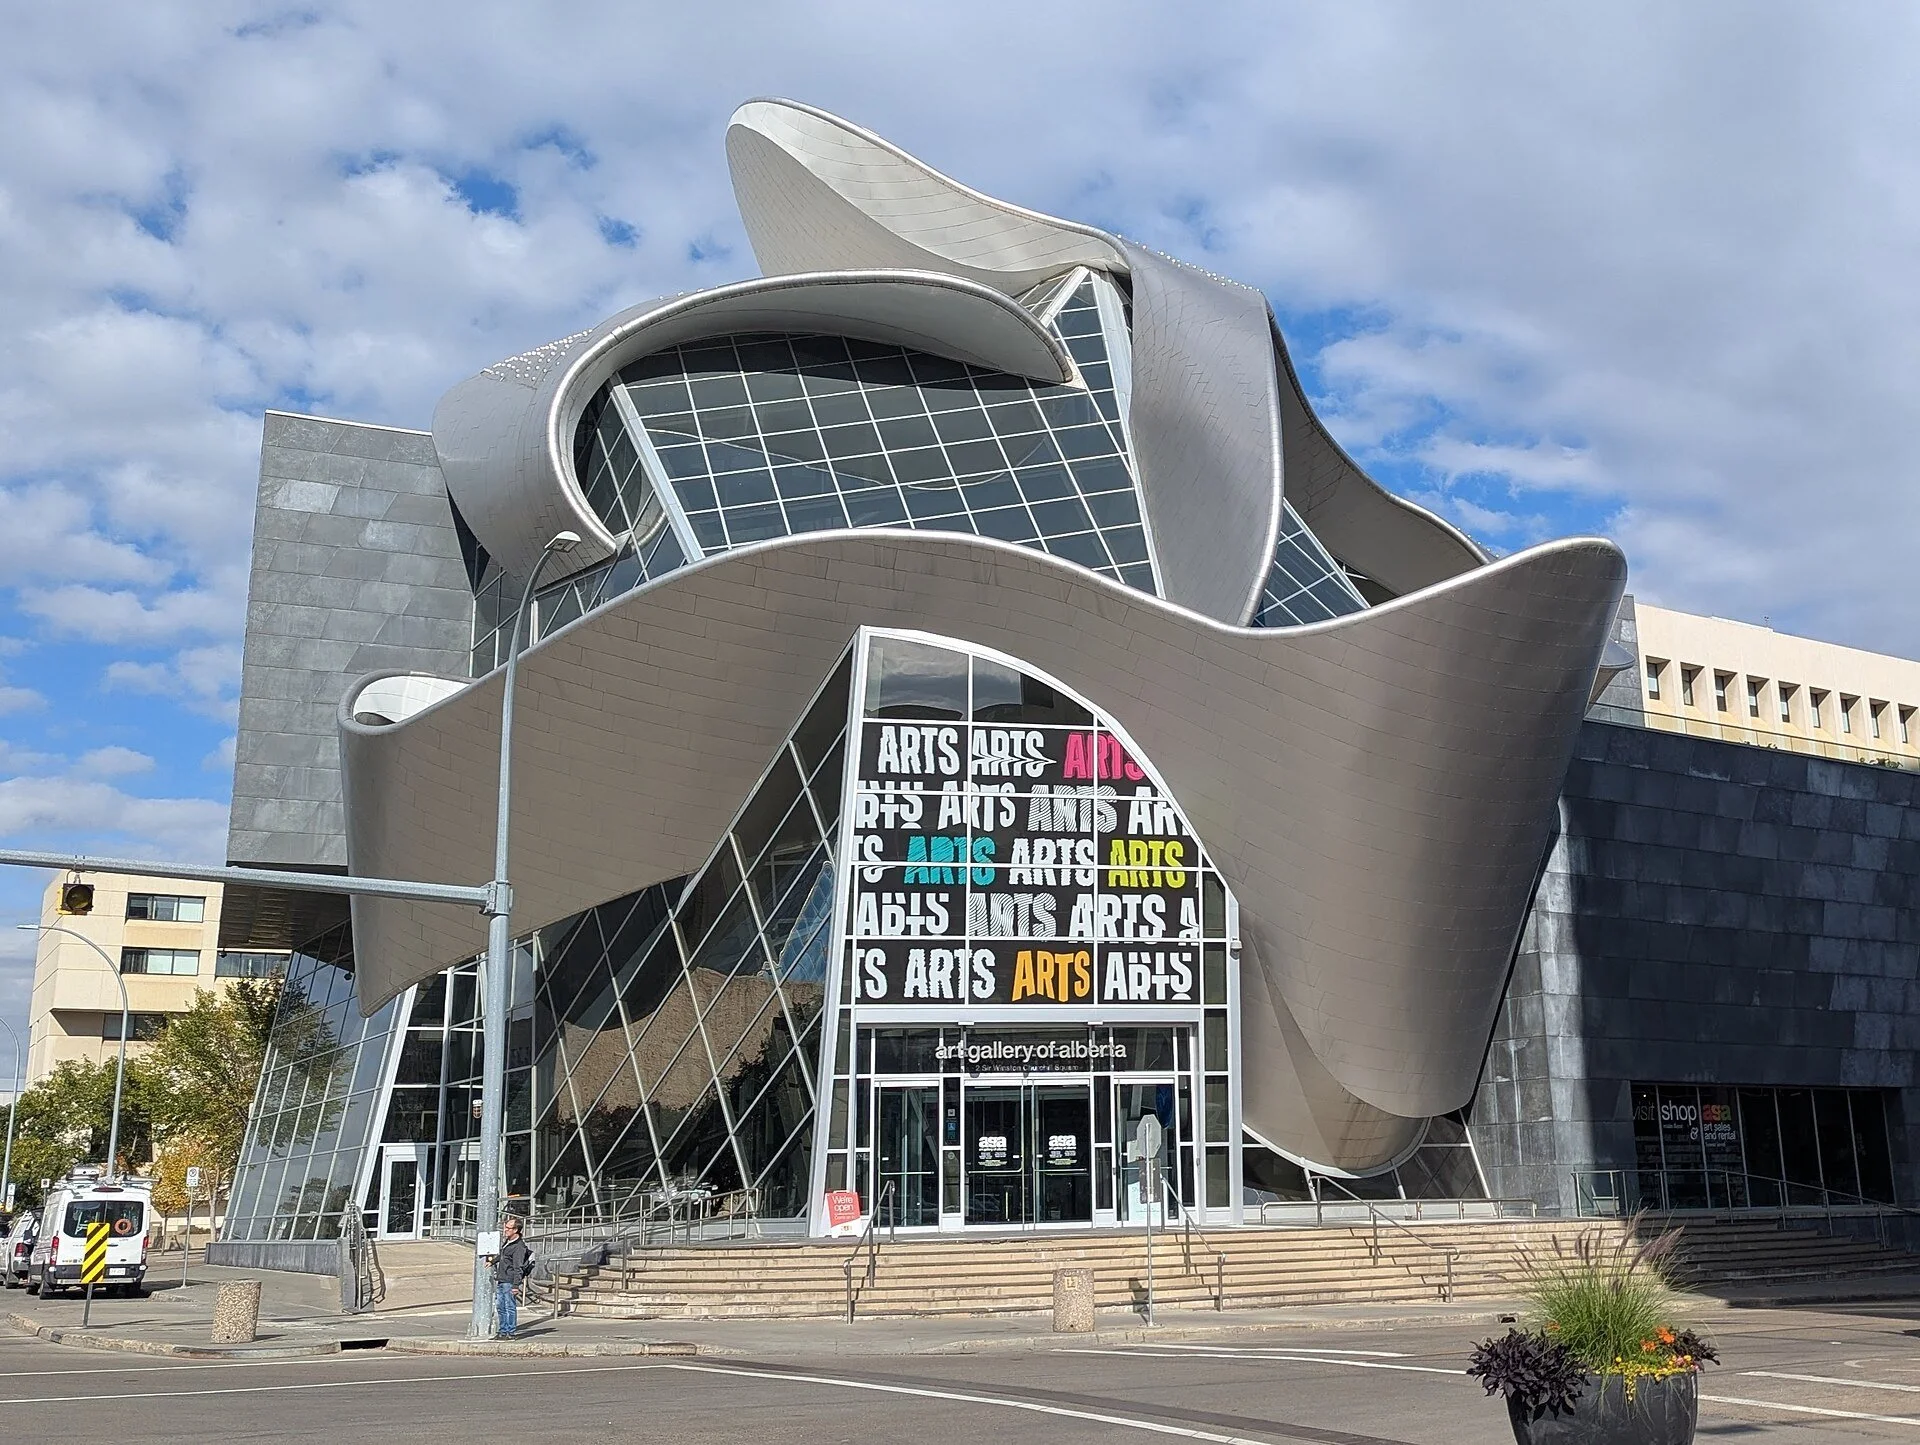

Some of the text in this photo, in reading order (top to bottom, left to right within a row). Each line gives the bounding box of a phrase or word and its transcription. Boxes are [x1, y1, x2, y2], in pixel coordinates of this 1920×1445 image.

[878, 726, 960, 775] ARTS
[971, 729, 1056, 778] ARTS
[937, 781, 1015, 832] ARTS
[1027, 785, 1117, 833] ARTS
[1127, 786, 1190, 836] AR
[904, 835, 996, 885] ARTS
[1009, 838, 1095, 886] ARTS
[1108, 840, 1186, 888] ARTS
[857, 892, 949, 936] ARTS
[968, 892, 1056, 942] ARTS
[1068, 893, 1166, 945] ARTS
[904, 948, 996, 999] ARTS
[1012, 951, 1091, 1003] ARTS
[1104, 952, 1192, 1000] ARTS
[935, 1041, 1127, 1063] art gallery of alberta
[982, 1064, 992, 1072] Sir
[993, 1064, 1022, 1072] Winston
[1055, 1064, 1079, 1073] Square
[1661, 1100, 1697, 1126] shop
[1690, 1127, 1698, 1140] &
[1704, 1122, 1731, 1132] art sales
[1704, 1131, 1736, 1140] and rental
